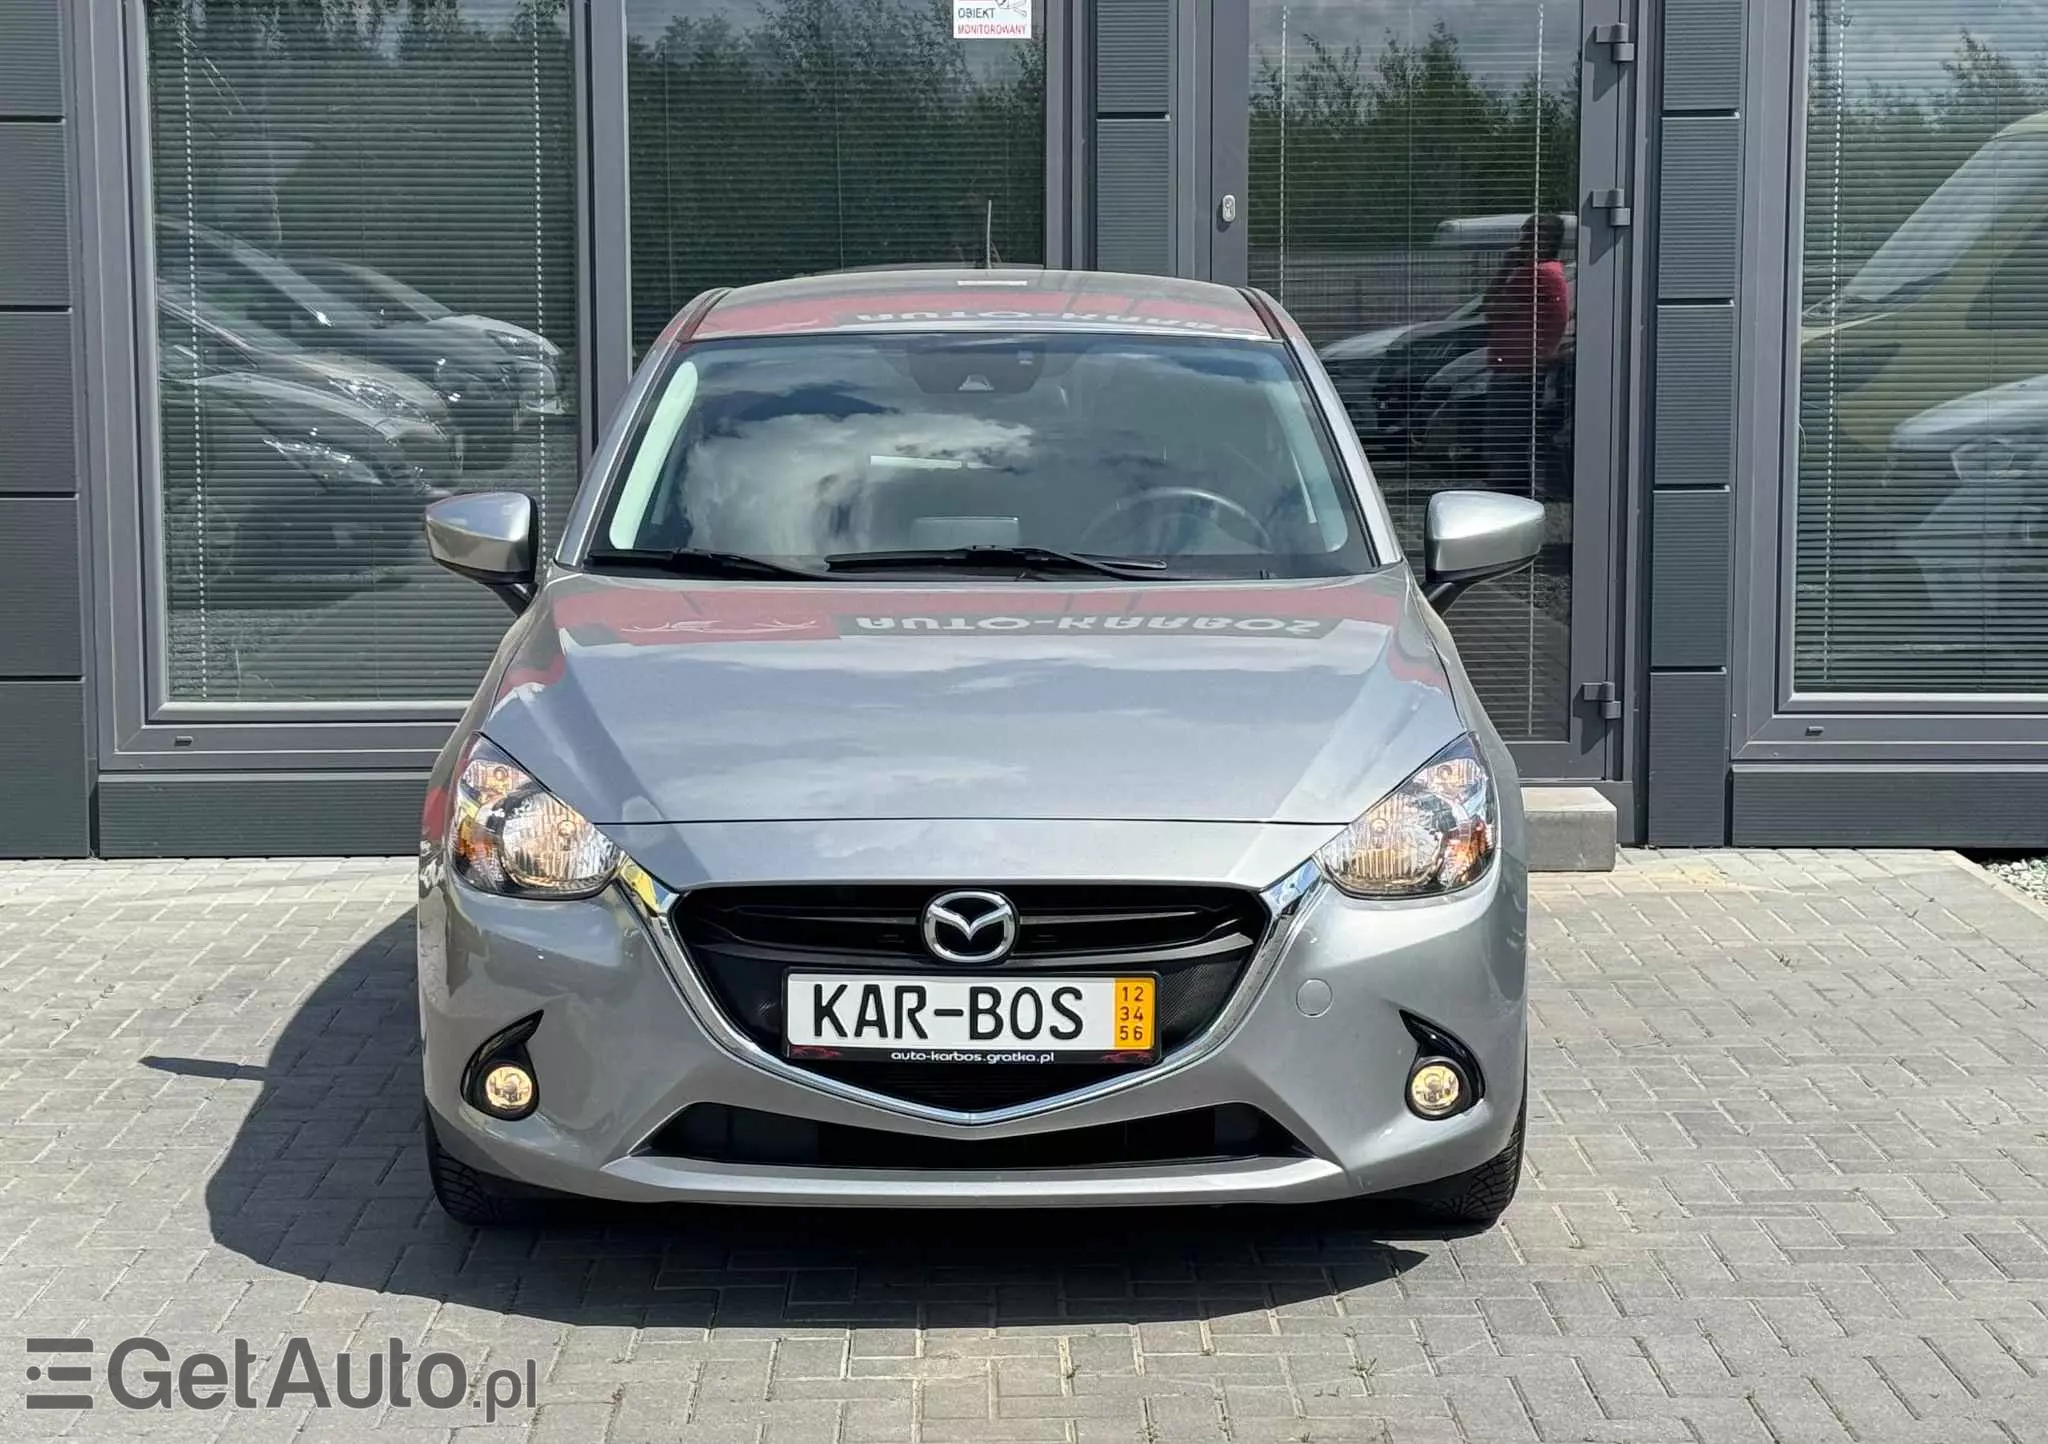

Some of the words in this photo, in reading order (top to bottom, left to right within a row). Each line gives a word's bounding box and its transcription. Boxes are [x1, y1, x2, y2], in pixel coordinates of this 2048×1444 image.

[957, 7, 996, 19] OBIEKT
[957, 23, 1026, 35] MONITOROWANY
[1122, 986, 1144, 1001] 12
[812, 983, 1084, 1041] KAR-BOS
[1120, 1006, 1144, 1021] 34
[1120, 1025, 1143, 1040] 56
[890, 1051, 1055, 1064] auto-karbos.gratka.pl
